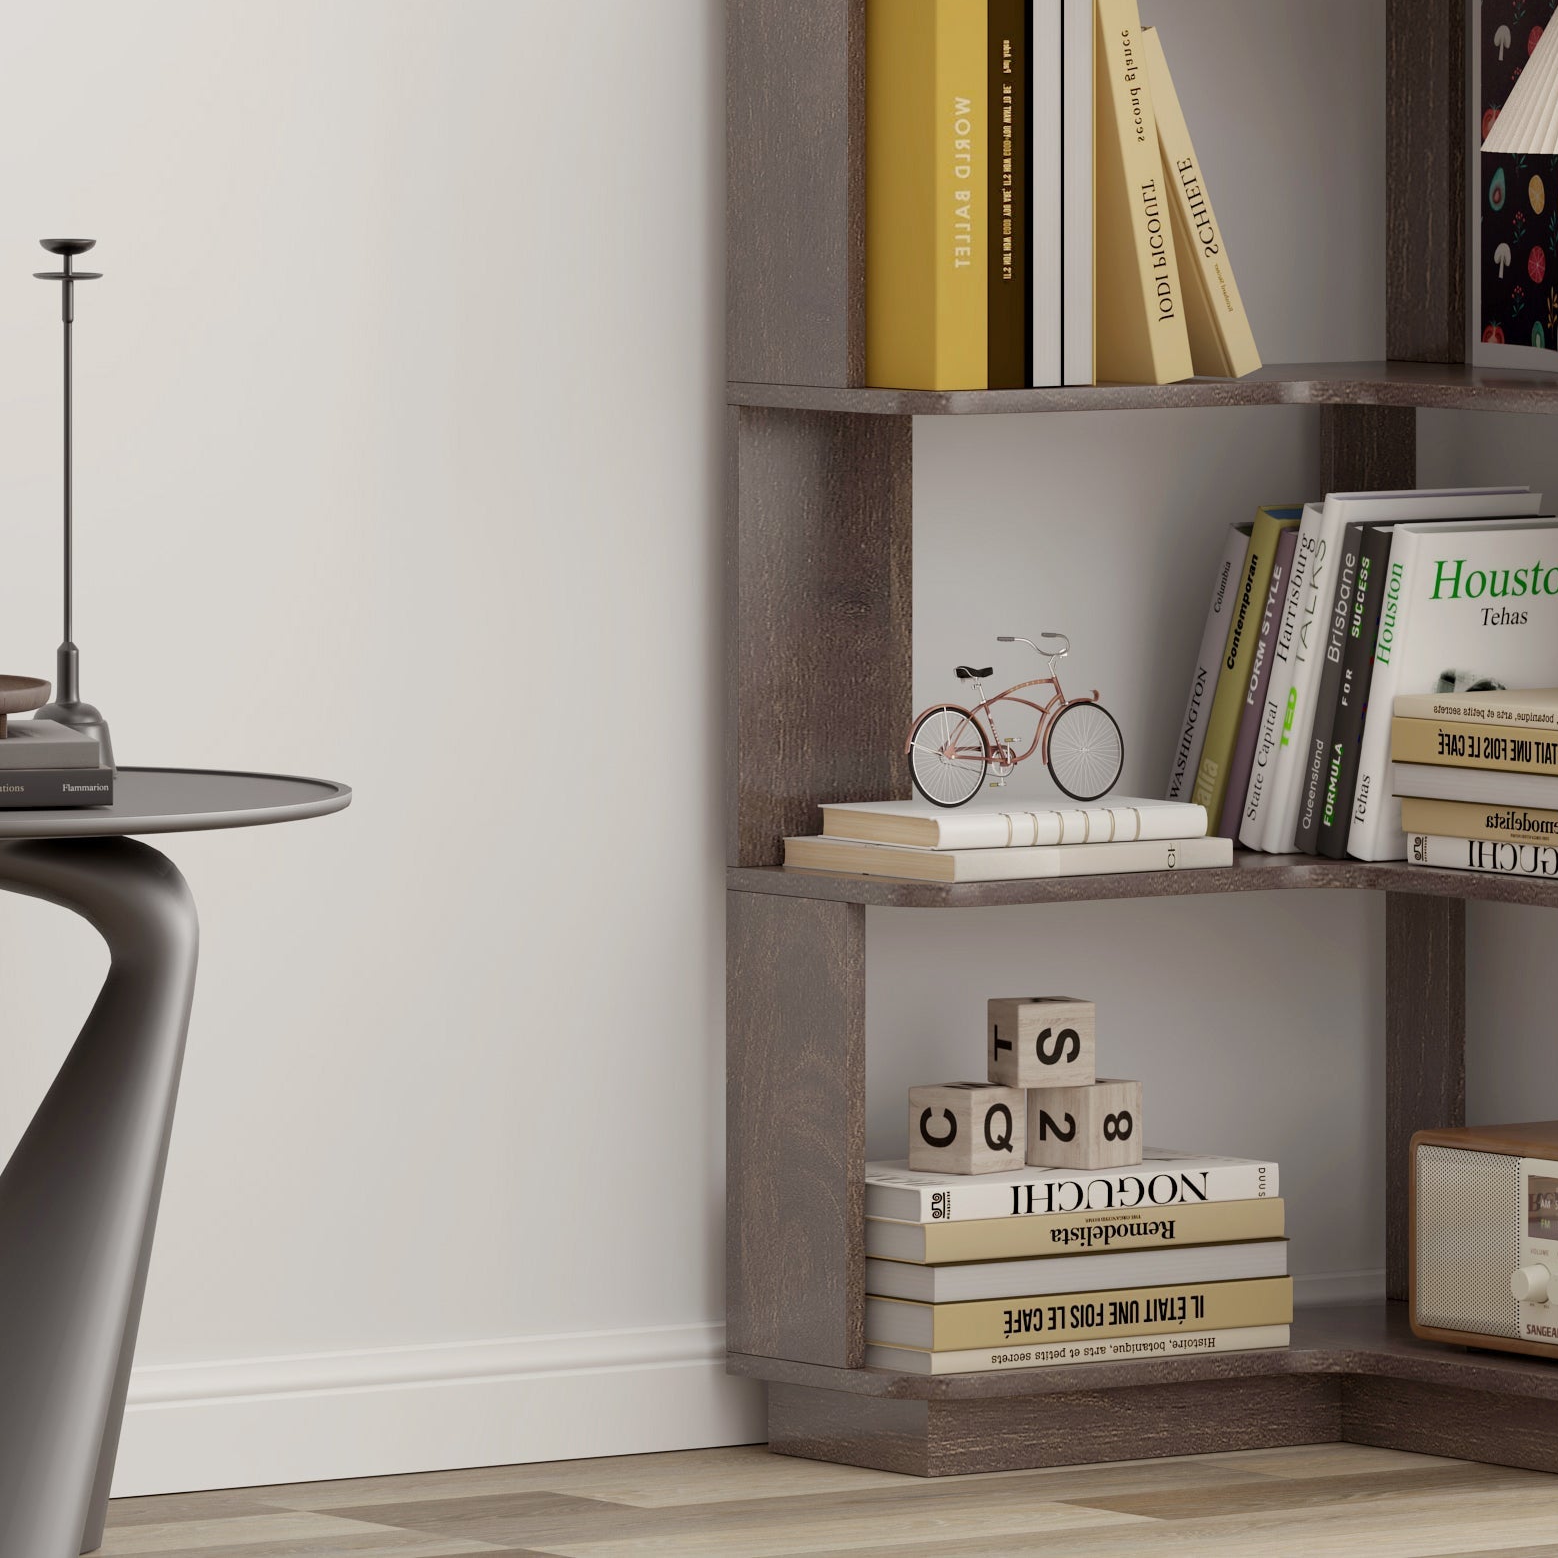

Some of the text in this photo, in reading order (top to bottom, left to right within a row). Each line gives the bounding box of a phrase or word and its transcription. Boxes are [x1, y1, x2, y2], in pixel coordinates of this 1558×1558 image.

[1213, 560, 1232, 614] Columbia
[1226, 553, 1258, 671] Contemporan
[1277, 532, 1316, 662] Harrisburg
[1327, 552, 1356, 664] Brisbane
[1246, 564, 1282, 705] FORM STYLE
[1376, 563, 1404, 666] Houston
[1480, 606, 1528, 627] Tehas
[1279, 538, 1327, 750] TED TALKS
[1323, 557, 1371, 827] FORMULA FOR SUCCESS
[1169, 666, 1208, 800] WASHINGTON
[1247, 700, 1278, 821] State Capital
[1302, 739, 1324, 830] Queensland
[62, 783, 109, 792] Flammarion
[1353, 774, 1371, 825] Tehas
[994, 1024, 1012, 1062] T
[1035, 1027, 1081, 1065] S
[920, 1106, 957, 1148] C
[984, 1103, 1013, 1153] Q
[1039, 1109, 1076, 1143] 2
[1103, 1110, 1133, 1142] 8
[1010, 1171, 1209, 1215] NOGUCHI
[1050, 1220, 1176, 1246] Remodelista
[1003, 1295, 1204, 1339] IL ÉTAIT UNE FOIS LE CAFÉ
[991, 1337, 1216, 1364] Histoire, botanique, arts et petits secrets
